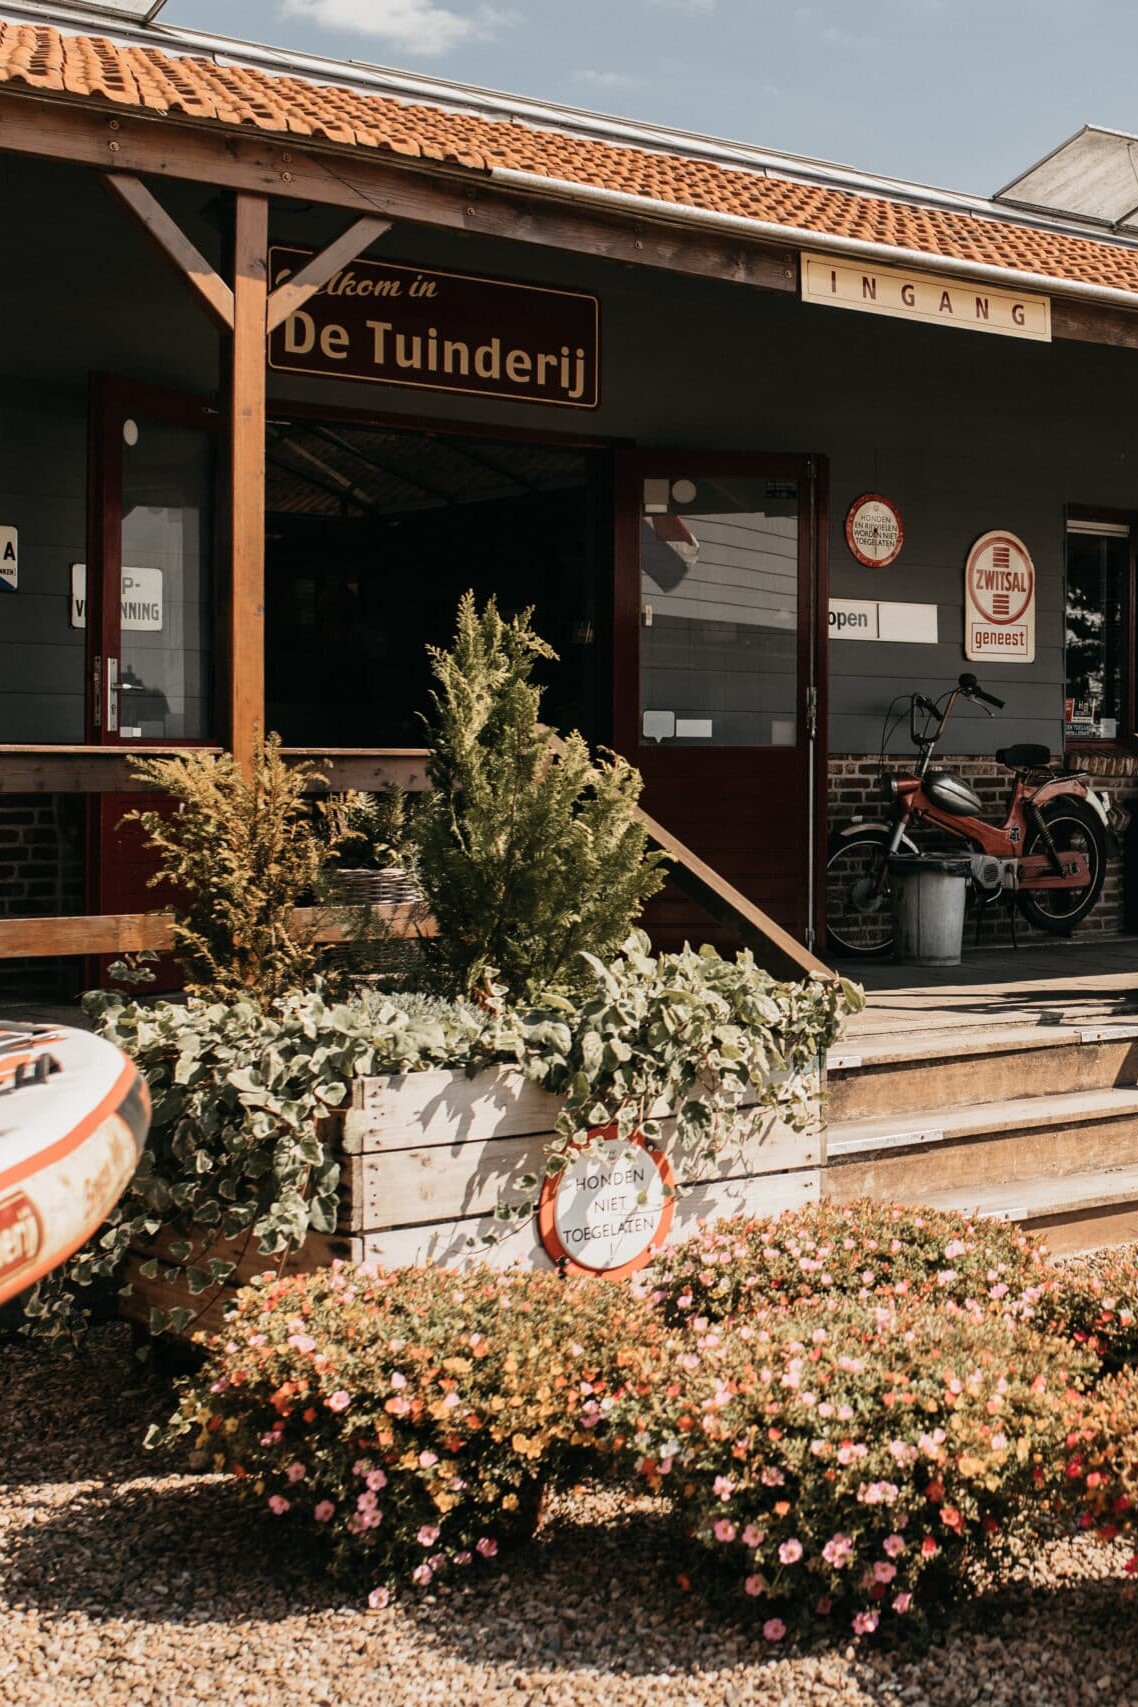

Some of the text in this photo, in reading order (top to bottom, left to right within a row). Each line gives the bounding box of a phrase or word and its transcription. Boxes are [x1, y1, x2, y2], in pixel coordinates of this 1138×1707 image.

[276, 268, 439, 298] lkom in
[831, 270, 1025, 326] INGANG
[284, 310, 585, 399] De Tuinderij
[854, 521, 864, 529] EN
[861, 515, 891, 523] HONDEN
[856, 538, 895, 546] TOEGELATEN
[975, 569, 1027, 593] ZWITSAL
[827, 611, 868, 631] open
[975, 631, 1025, 649] geneest
[576, 1169, 644, 1191] HONDEN
[594, 1196, 627, 1214] NIET
[562, 1217, 654, 1244] TOEGELATEN
